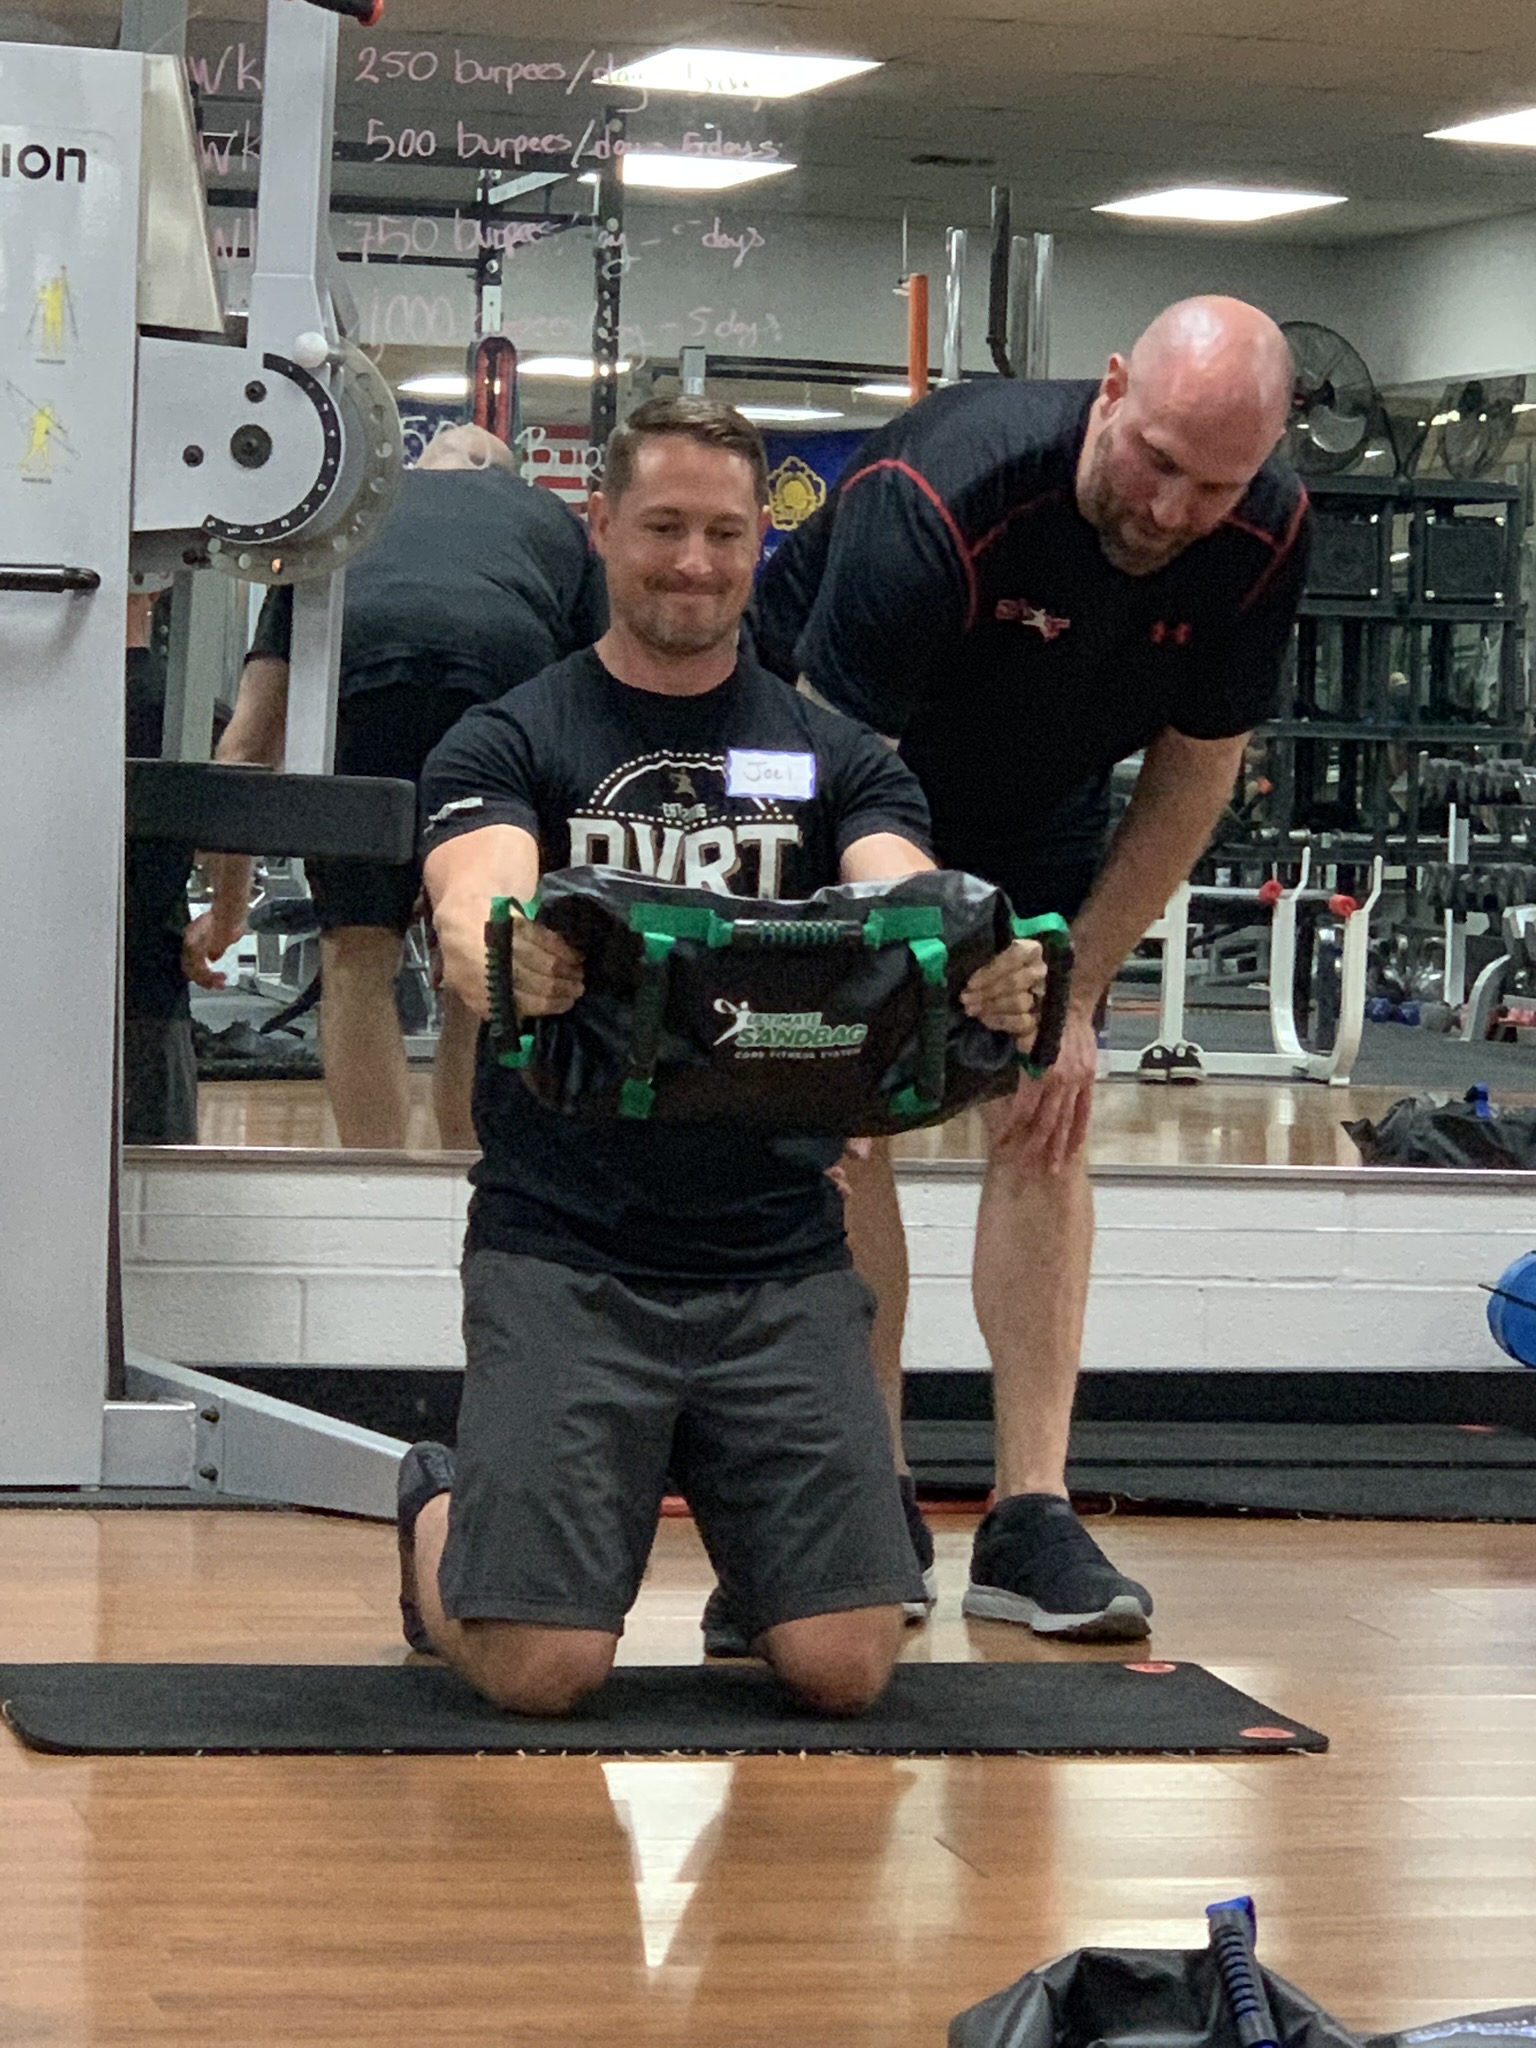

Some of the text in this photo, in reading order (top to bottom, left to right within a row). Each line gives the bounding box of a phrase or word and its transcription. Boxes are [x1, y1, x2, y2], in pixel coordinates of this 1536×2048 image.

[354, 46, 438, 83] 250
[367, 118, 437, 162] 500
[735, 1024, 868, 1047] SANDBAG
